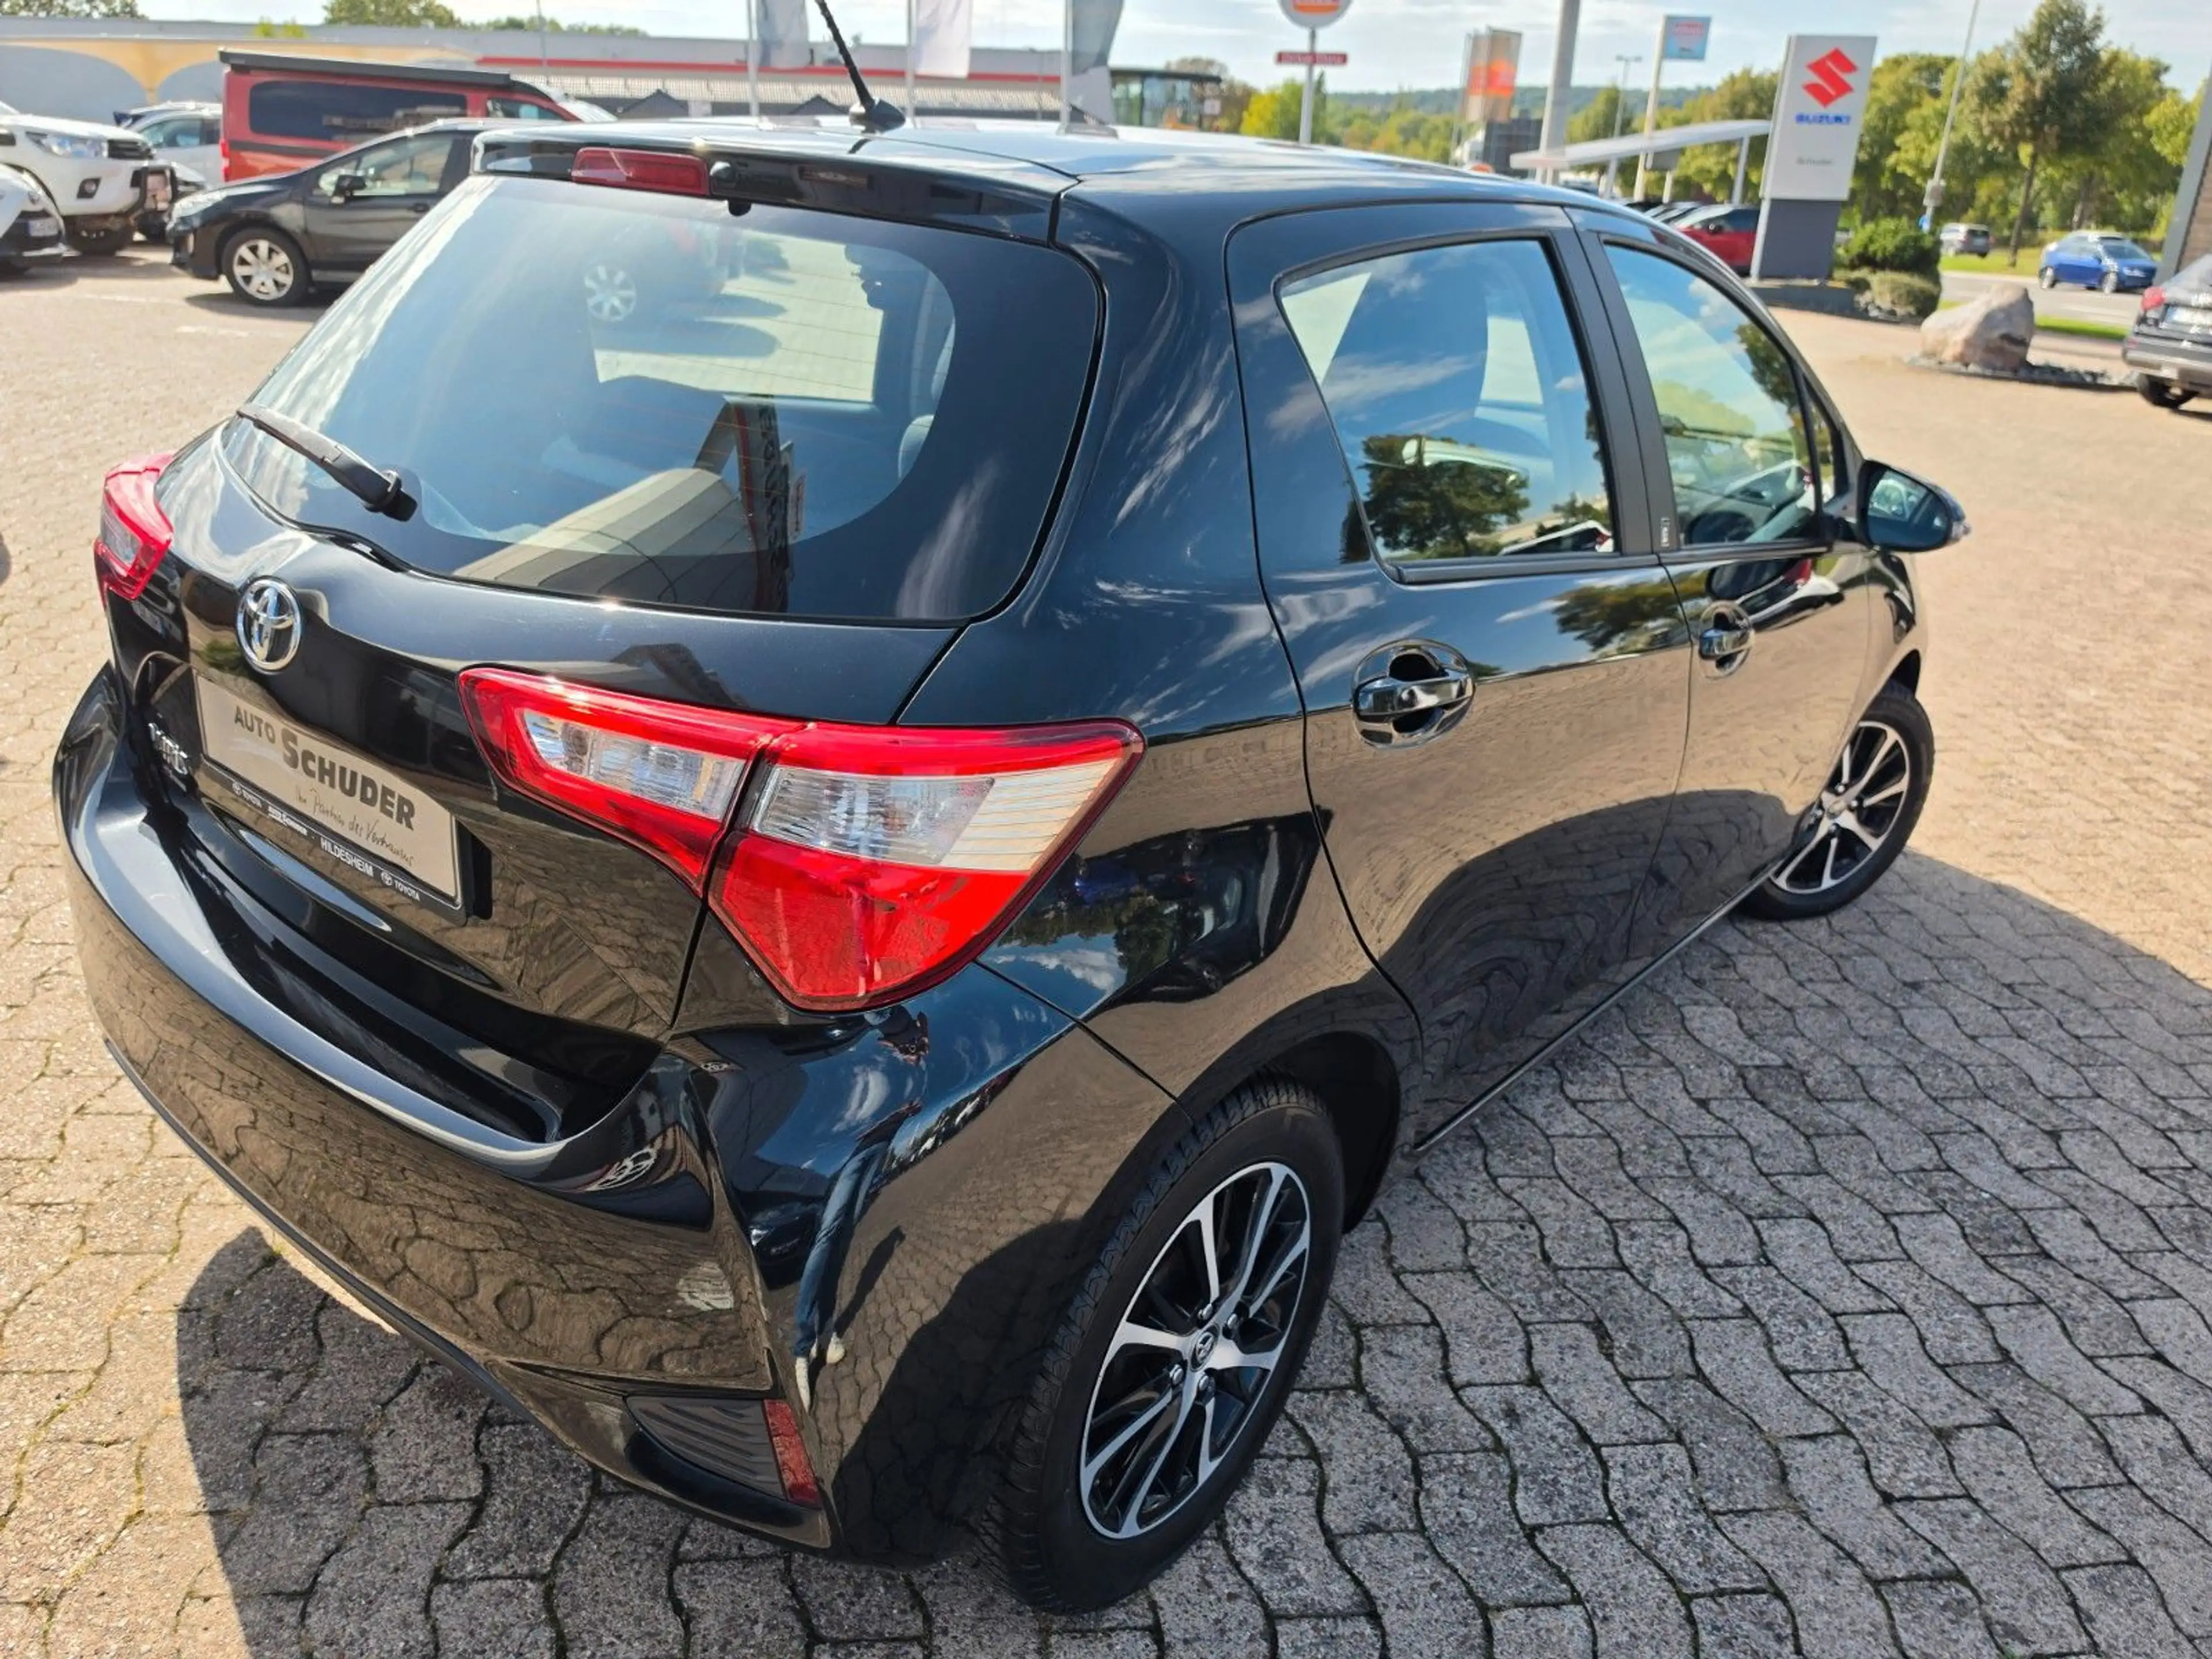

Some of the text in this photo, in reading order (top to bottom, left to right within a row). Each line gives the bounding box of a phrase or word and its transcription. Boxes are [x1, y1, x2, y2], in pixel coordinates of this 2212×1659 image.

[1795, 113, 1851, 124] SUZUKI
[235, 705, 276, 744] AUTO
[348, 815, 364, 837] des
[320, 836, 374, 877] HILDESHEIM
